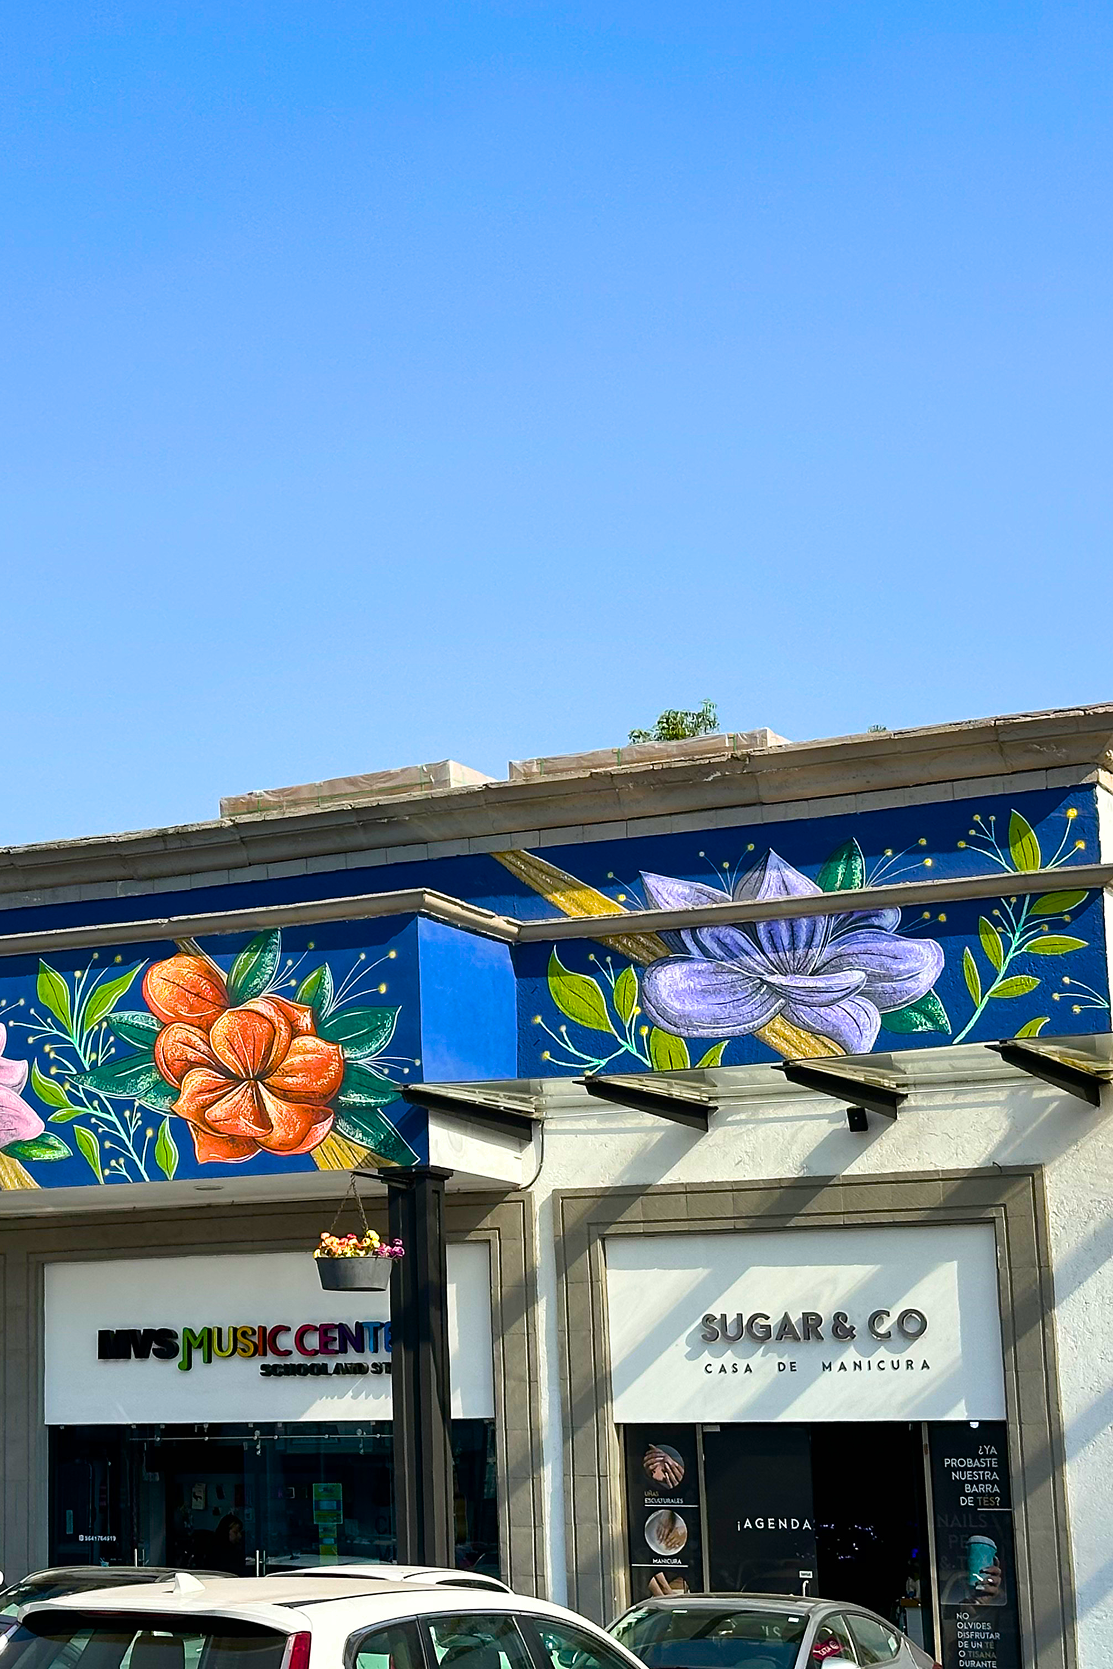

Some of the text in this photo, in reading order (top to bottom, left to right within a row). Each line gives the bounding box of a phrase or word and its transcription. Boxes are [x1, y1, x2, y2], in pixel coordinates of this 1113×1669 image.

[701, 1308, 928, 1343] SUGAR & CO
[178, 1325, 293, 1371] MUSIC
[371, 1361, 392, 1375] ST
[704, 1359, 931, 1374] CASA DE MANICURA
[978, 1445, 998, 1455] ¿YA
[944, 1458, 998, 1468] PROBASTE
[951, 1471, 1000, 1480] NUESTRA
[964, 1484, 1001, 1493] BARRA
[959, 1496, 974, 1506] DE
[956, 1612, 970, 1620] NO
[957, 1621, 992, 1630] OLVIDES
[957, 1631, 1001, 1640] DISFRUTAR
[958, 1640, 969, 1649] DE
[971, 1641, 983, 1649] UN
[958, 1650, 966, 1658] O
[959, 1659, 997, 1669] DURANTE
